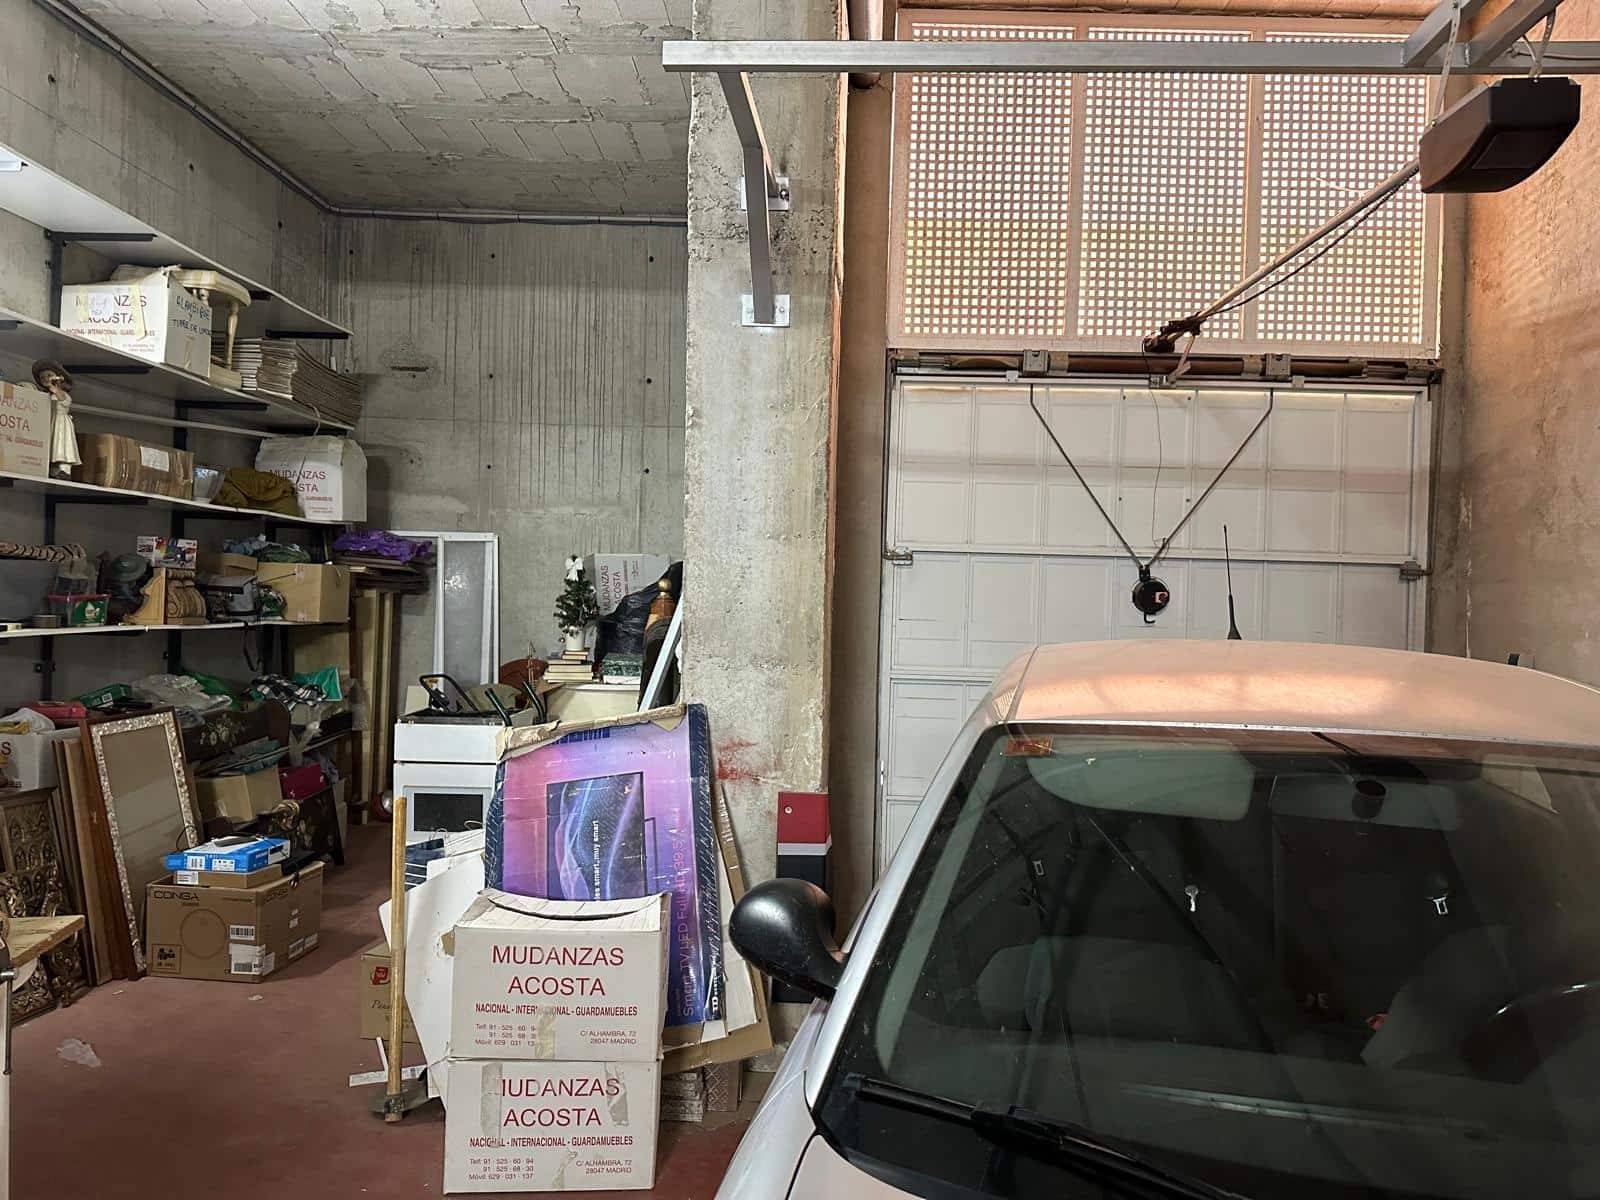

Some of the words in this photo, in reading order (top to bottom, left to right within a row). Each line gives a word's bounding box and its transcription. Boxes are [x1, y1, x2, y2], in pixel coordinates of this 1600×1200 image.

[153, 889, 200, 901] CONGA
[678, 922, 690, 950] LED
[492, 945, 624, 966] MUDANZAS
[507, 975, 606, 996] ACOSTA
[682, 975, 695, 1018] Smart
[475, 1003, 511, 1014] NACIONAL
[575, 1006, 638, 1016] GUARDAMUEBLES
[503, 1108, 602, 1127] ACOSTA
[510, 1137, 566, 1147] INTERNACIONAL
[571, 1136, 633, 1146] GUARDAMUEBLES
